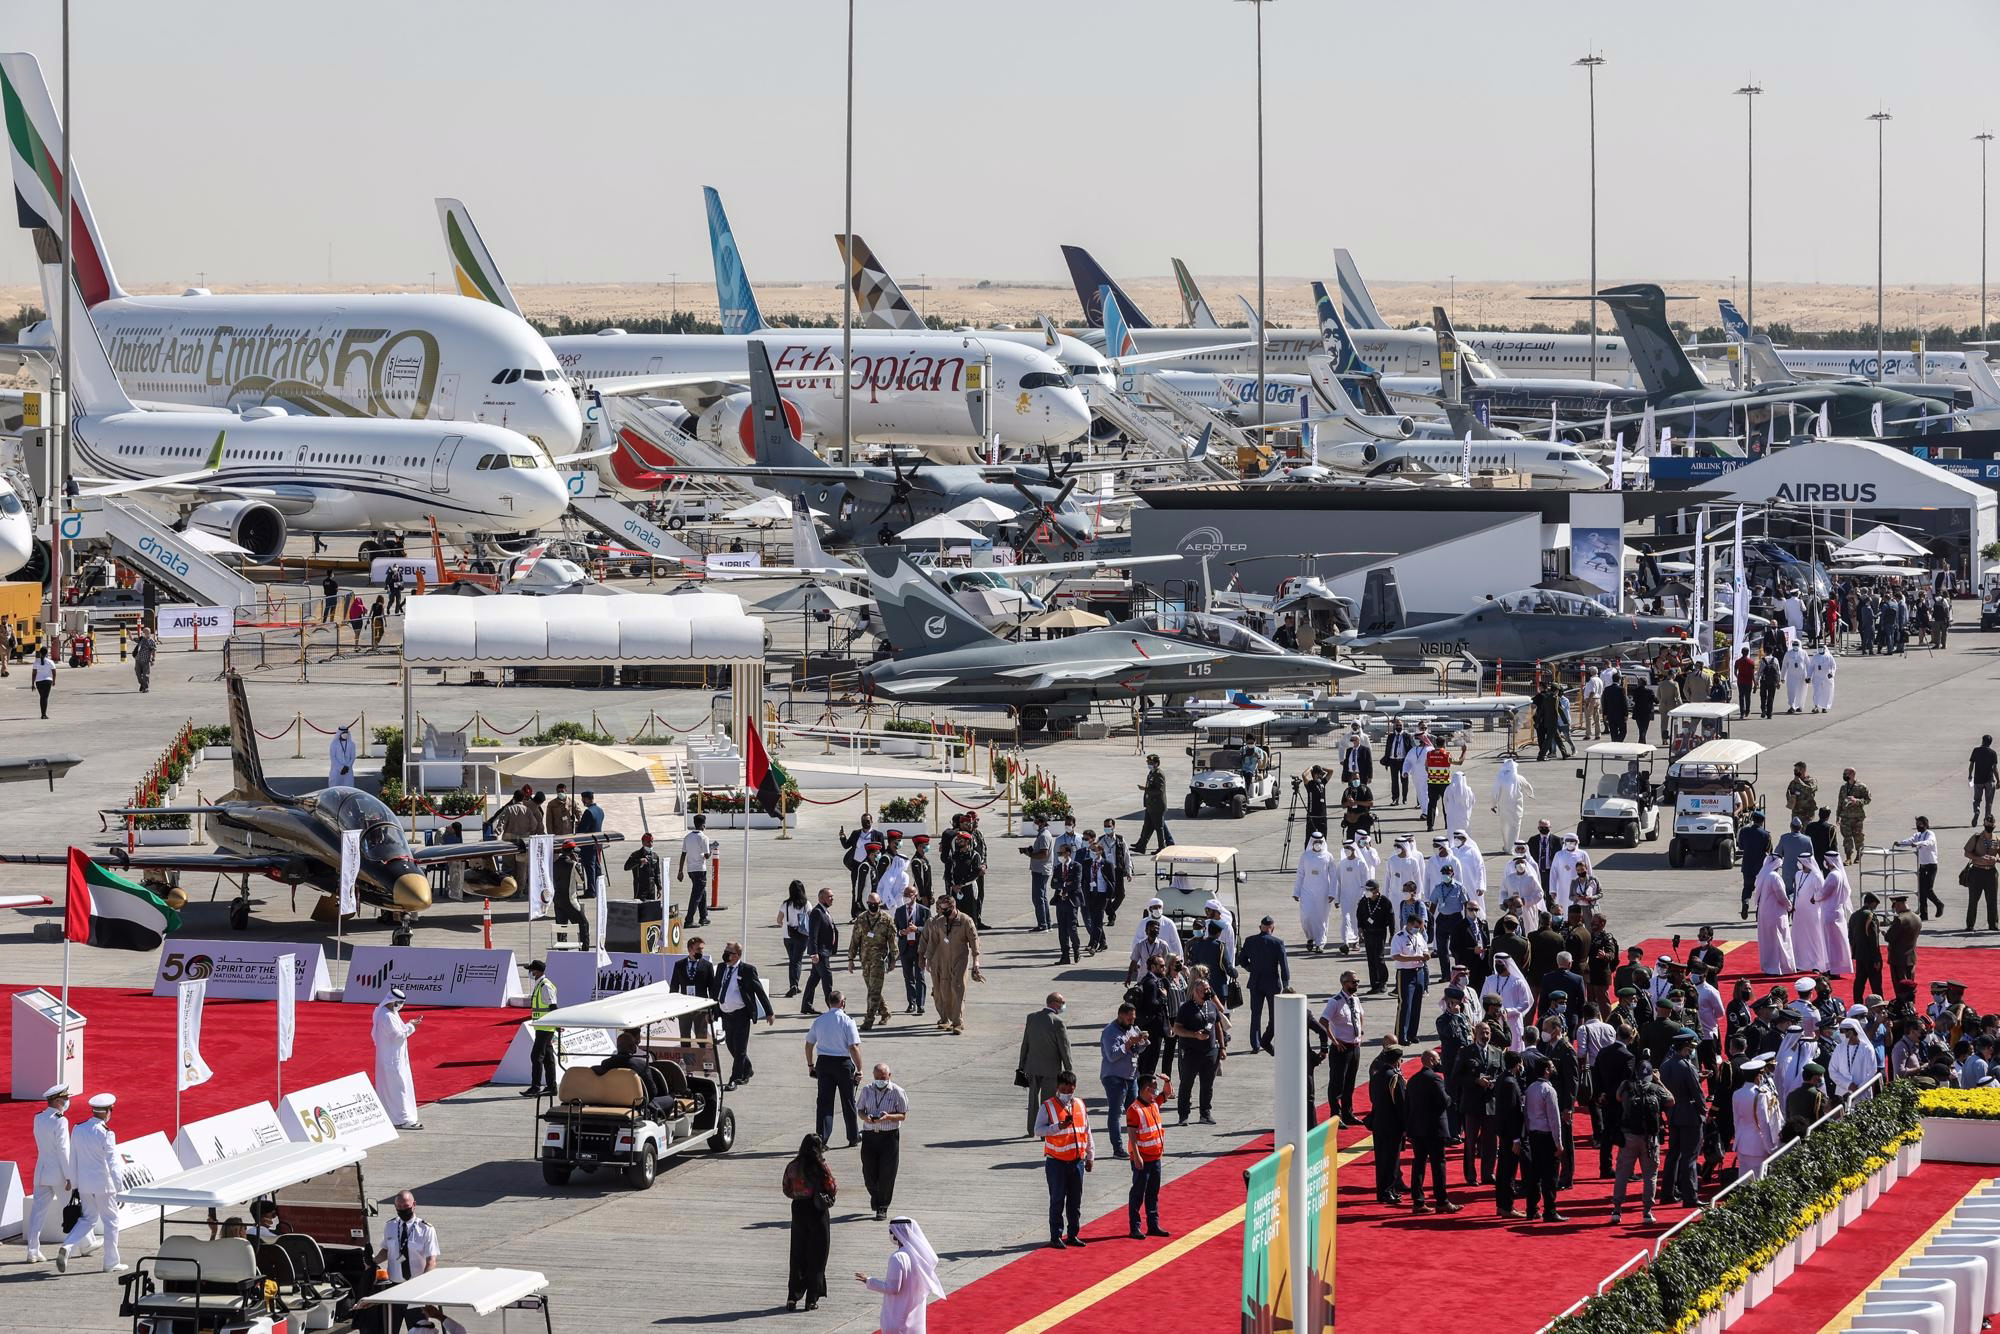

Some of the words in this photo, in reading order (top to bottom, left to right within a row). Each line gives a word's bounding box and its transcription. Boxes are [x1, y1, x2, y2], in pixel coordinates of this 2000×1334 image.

[724, 309, 748, 328] 777
[1265, 339, 1325, 353] ETIHA
[1491, 340, 1556, 353] السعودية
[107, 336, 164, 372] United
[161, 336, 205, 373] Arab
[206, 324, 334, 390] Emirates
[333, 328, 440, 420] 50
[775, 345, 965, 404] Ethopian
[664, 428, 686, 448] dnata
[1690, 462, 1721, 470] AIRLINK
[1776, 483, 1877, 503] AIRBUS
[624, 519, 661, 550] dnata
[1185, 543, 1247, 552] AEROTER
[139, 537, 190, 577] dnata
[1063, 551, 1084, 562] 608
[385, 566, 426, 576] ARBUS
[1419, 642, 1470, 655] N610AT
[1188, 664, 1212, 676] L15
[215, 965, 243, 973] SPIRIT
[245, 966, 257, 974] OF
[259, 966, 276, 974] THE
[405, 984, 442, 992] EMIRATES
[564, 1036, 578, 1048] SPIRIT
[577, 1035, 583, 1044] OF
[582, 1034, 590, 1043] THE
[590, 1030, 604, 1041] UNION
[332, 1110, 347, 1123] SPIRIT
[347, 1108, 354, 1118] OF
[353, 1105, 364, 1115] THE
[364, 1102, 379, 1113] UNION
[1251, 1235, 1260, 1253] OF
[1260, 1220, 1280, 1248] FLIGHT
